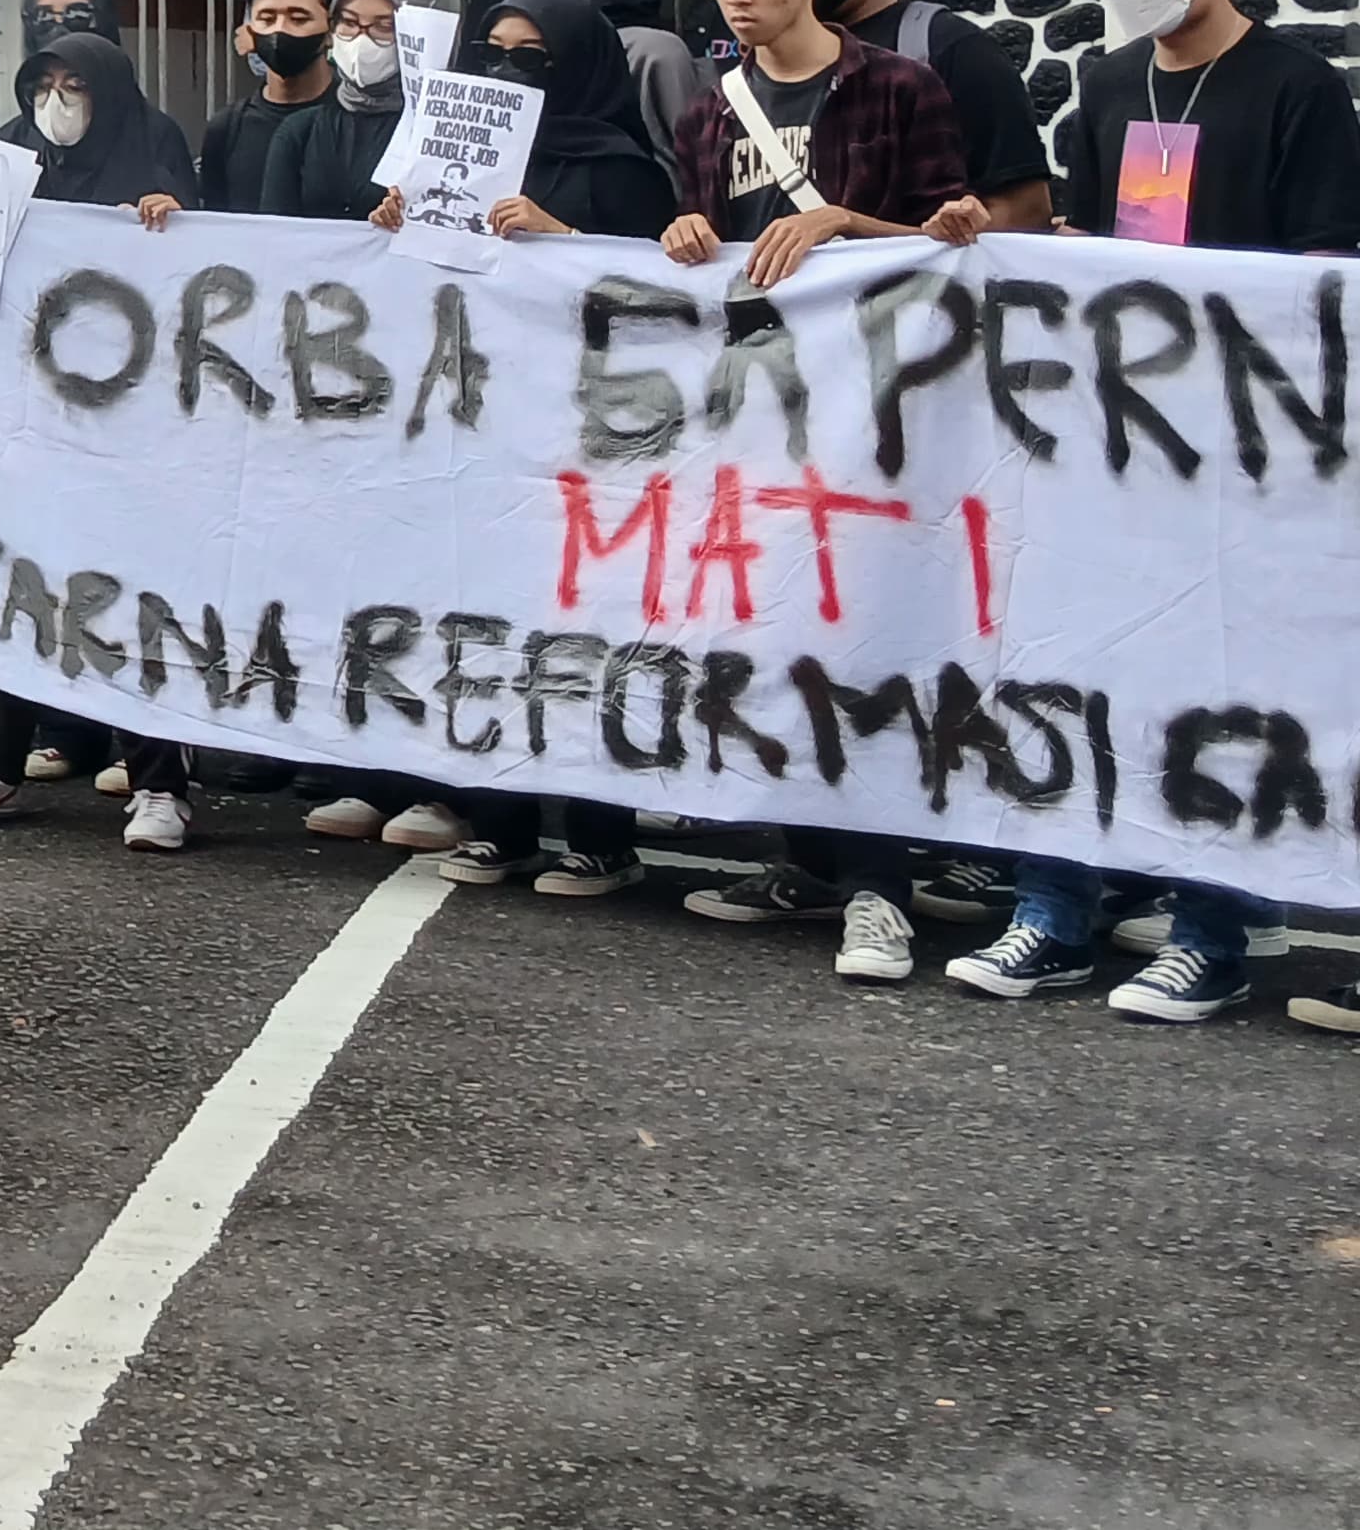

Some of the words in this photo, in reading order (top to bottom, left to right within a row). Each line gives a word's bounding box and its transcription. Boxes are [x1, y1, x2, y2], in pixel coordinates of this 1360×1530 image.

[426, 77, 468, 101] KAYAK
[468, 85, 524, 111] KURANG
[424, 100, 482, 123] KERJAAN
[434, 121, 492, 146] NGAMBIL
[421, 138, 469, 163] DOUBLE
[471, 149, 499, 168] JOB
[32, 264, 490, 439] ORBA
[554, 464, 996, 638] MATI
[340, 604, 1117, 832] REFORMASI
